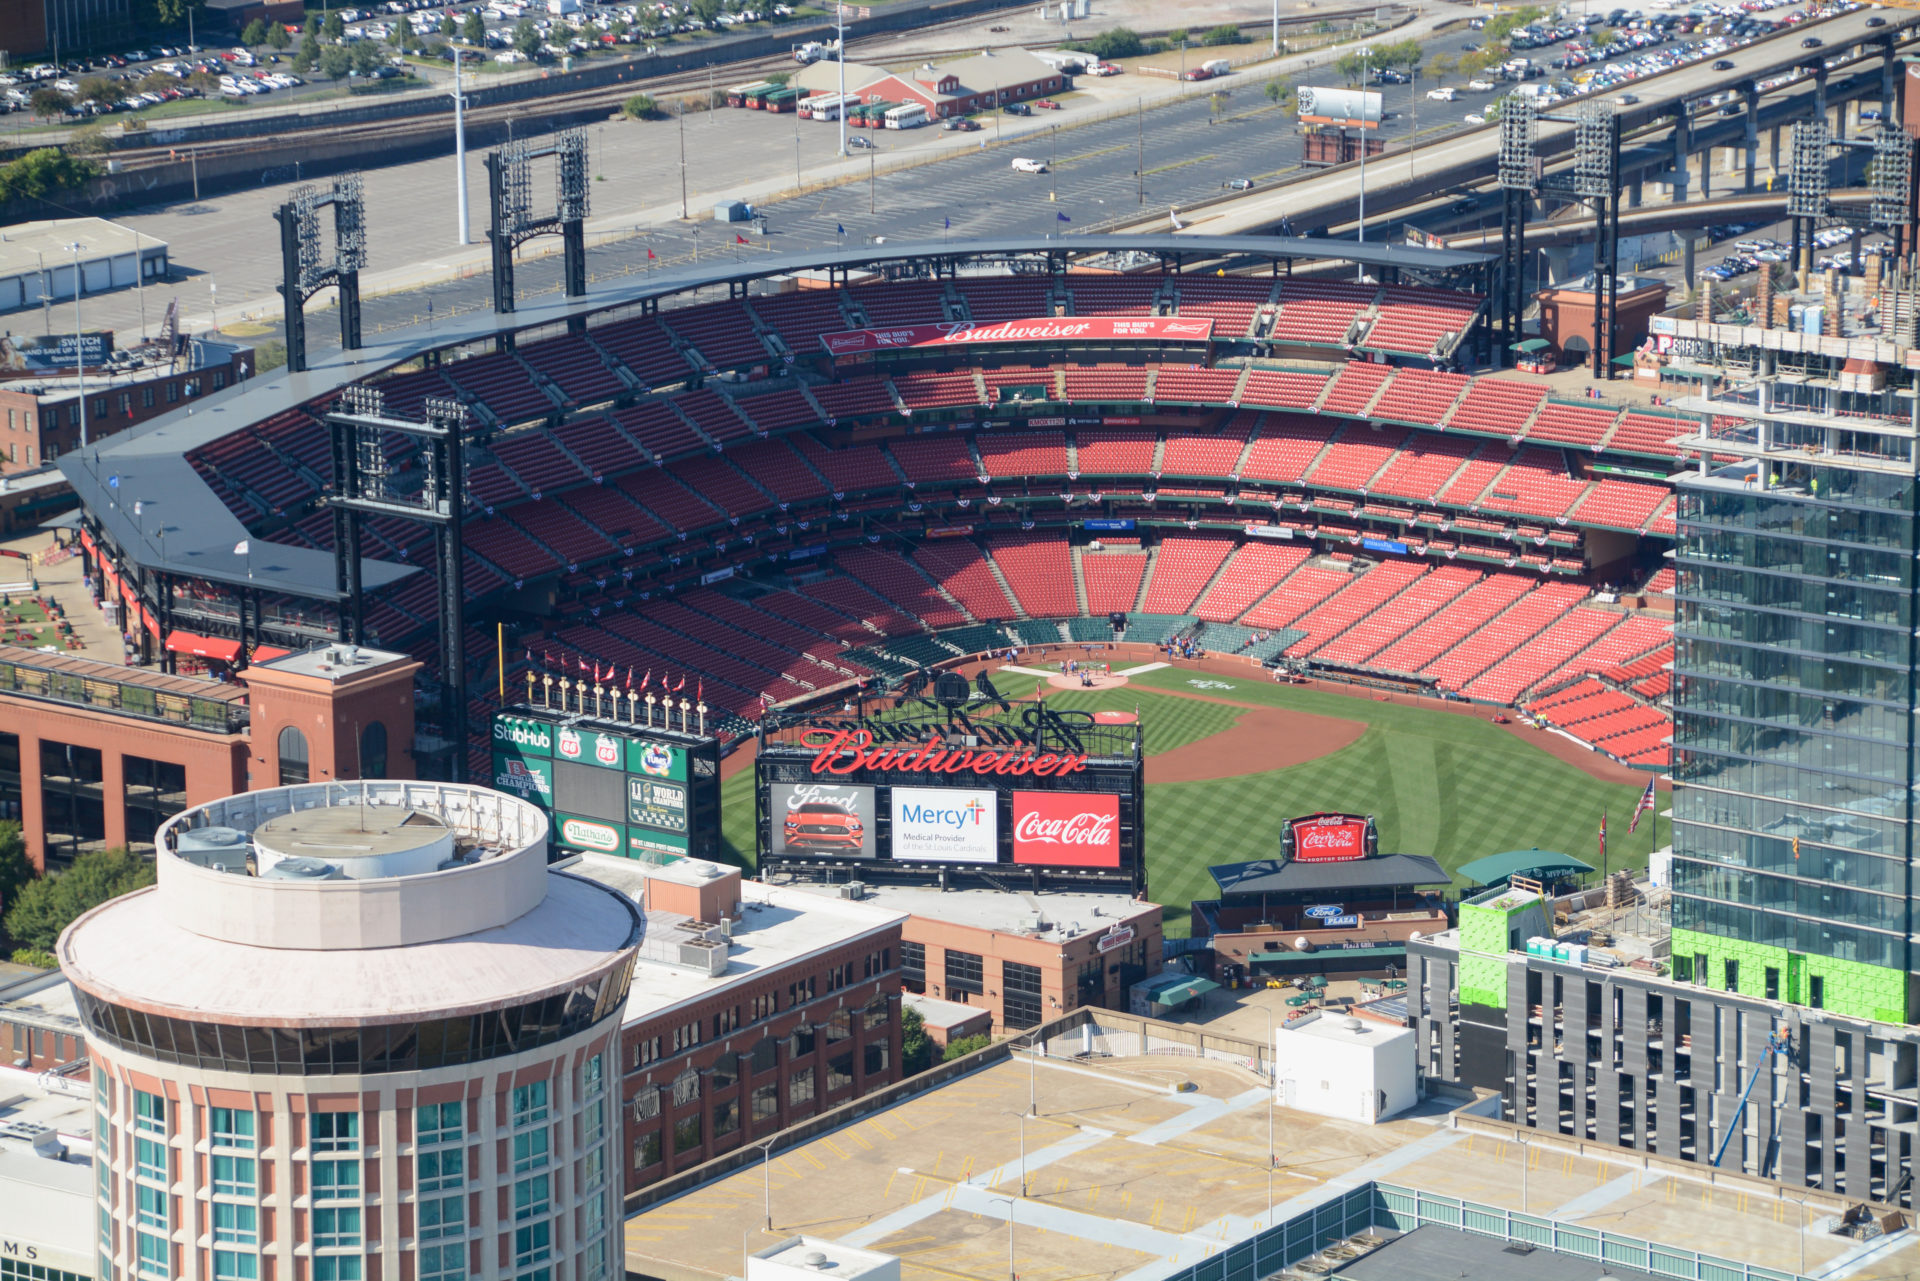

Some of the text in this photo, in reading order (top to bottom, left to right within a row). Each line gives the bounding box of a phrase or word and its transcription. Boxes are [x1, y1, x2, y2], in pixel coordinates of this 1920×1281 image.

[892, 330, 915, 338] BUD'S
[936, 321, 1090, 342] Budweiser
[61, 337, 101, 347] SWTCH
[494, 723, 550, 748] StubHub
[563, 741, 576, 753] 66
[600, 748, 614, 759] 66
[800, 728, 1088, 776] Budweiser
[647, 755, 668, 765] TUMS
[496, 776, 550, 793] CHAMPIONS
[631, 782, 642, 795] 11
[653, 785, 684, 801] WORLD
[787, 784, 858, 812] Ford
[902, 803, 967, 829] Mercy
[568, 823, 613, 842] Nathan's
[1015, 811, 1117, 845] Coca-Cola
[903, 833, 965, 842] Medical Provider
[903, 842, 911, 850] of
[934, 844, 952, 852] Louis
[953, 844, 986, 853] Cardinals
[1312, 906, 1336, 916] Ford
[1327, 916, 1354, 925] PLAZA
